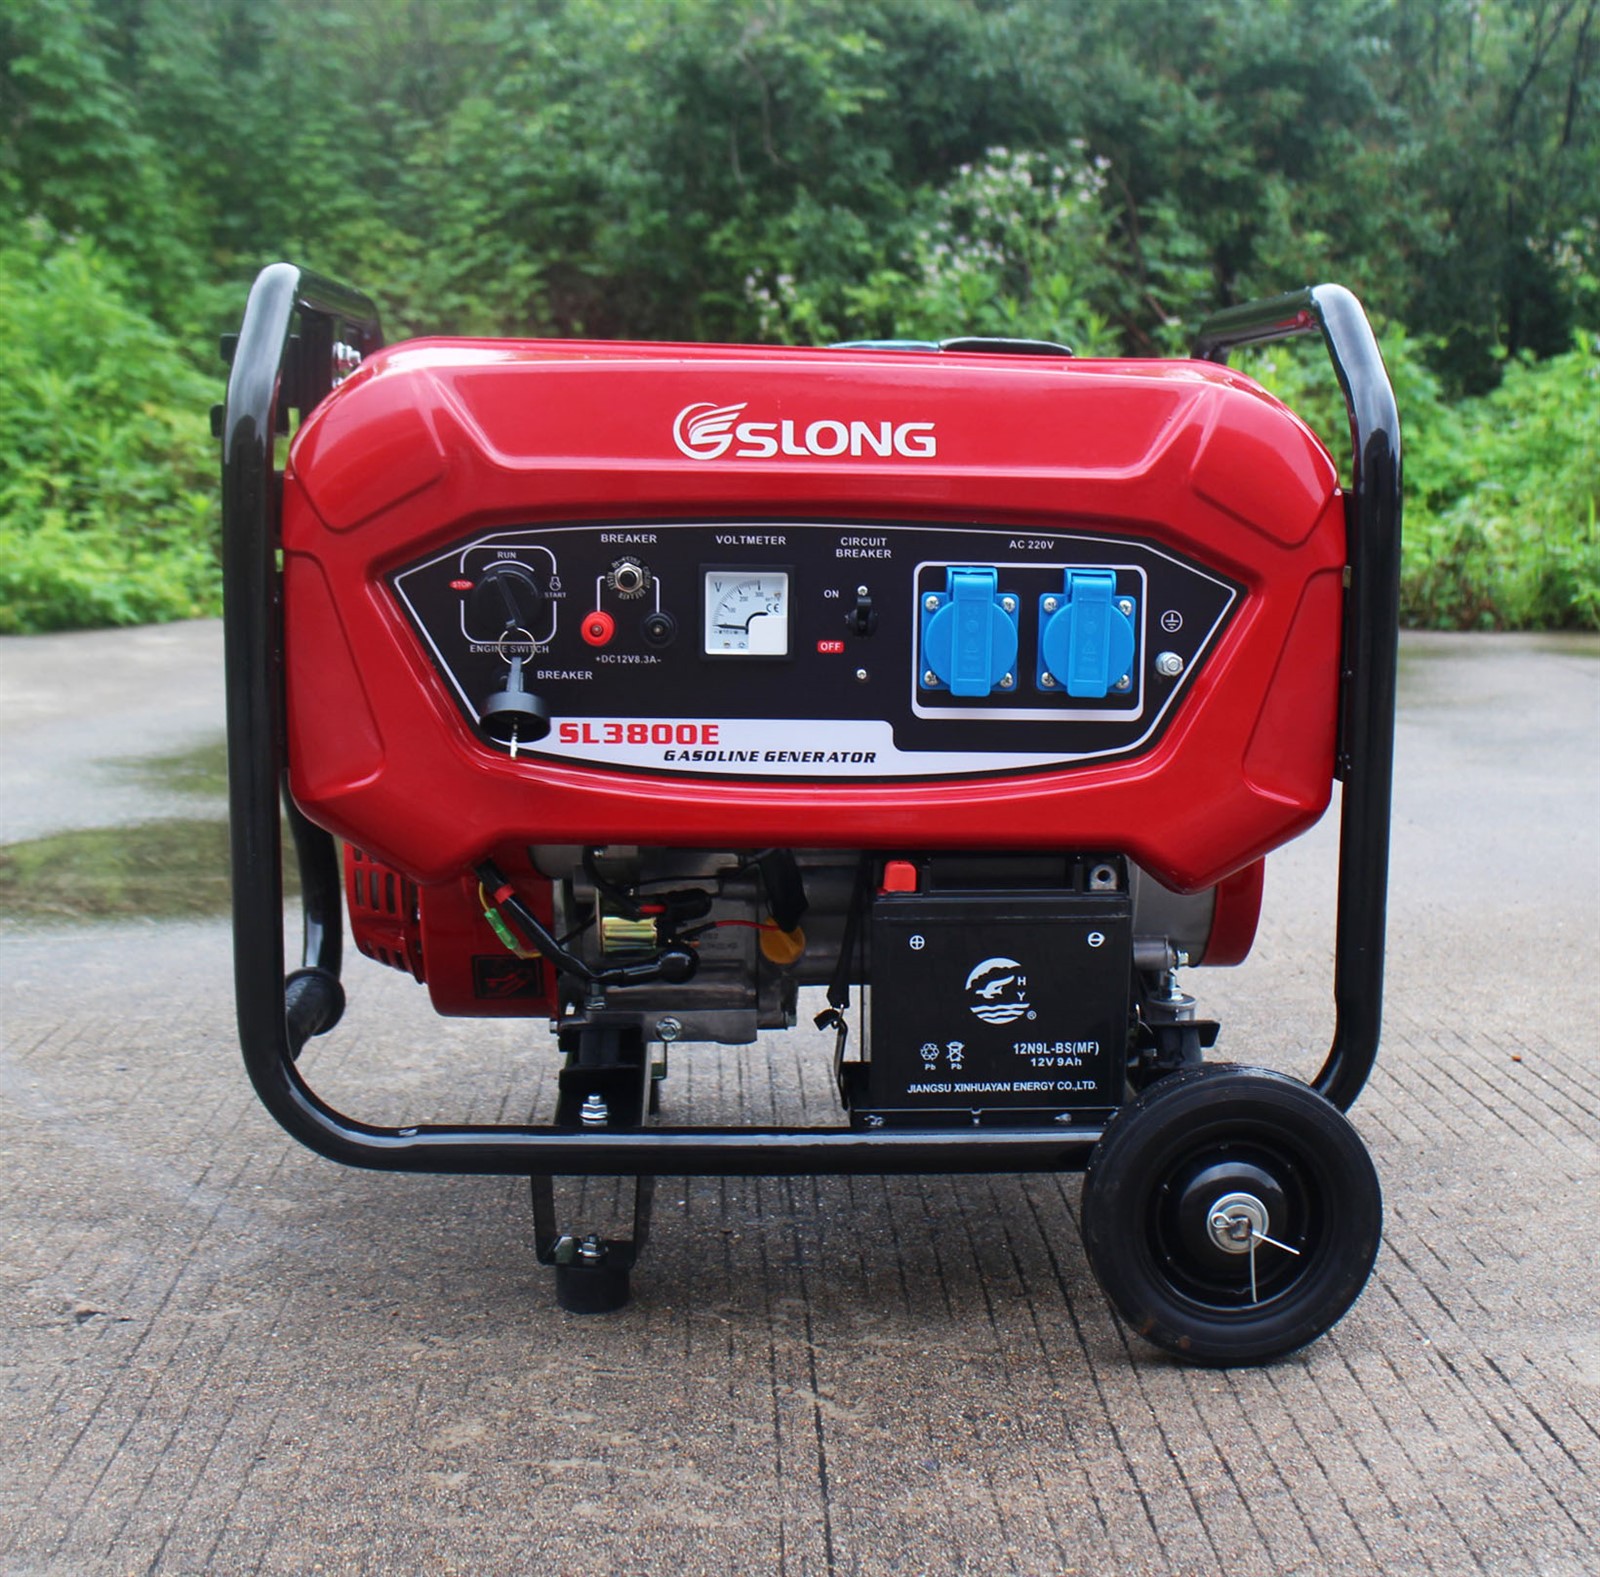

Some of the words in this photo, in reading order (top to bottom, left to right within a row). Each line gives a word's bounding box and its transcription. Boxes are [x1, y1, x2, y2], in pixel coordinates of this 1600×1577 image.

[735, 420, 937, 458] SLONG
[600, 533, 658, 544] BREAKER
[715, 535, 787, 545] VOLTMETER
[840, 537, 888, 547] CIRCUIT
[1009, 540, 1026, 550] AC
[1028, 540, 1055, 550] 220V
[497, 551, 517, 559] RUN
[835, 549, 892, 559] BREAKER
[451, 580, 474, 589] STOP
[824, 589, 839, 598] ON
[469, 644, 508, 653] ENGINE
[510, 645, 550, 654] SWITCH
[820, 641, 841, 651] OFF
[537, 670, 593, 680] BREAKER
[559, 722, 719, 745] SL3800E
[663, 749, 759, 762] GASOLINE
[763, 750, 877, 763] GENERATOR
[1013, 1041, 1100, 1056] 12N9L-BS(MF)
[1030, 1057, 1053, 1067] 12V
[1057, 1057, 1082, 1067] 9Ah
[907, 1084, 951, 1093] JIANGSU
[954, 1083, 1011, 1092] XINHUAYAN
[1013, 1082, 1054, 1091] ENERGY
